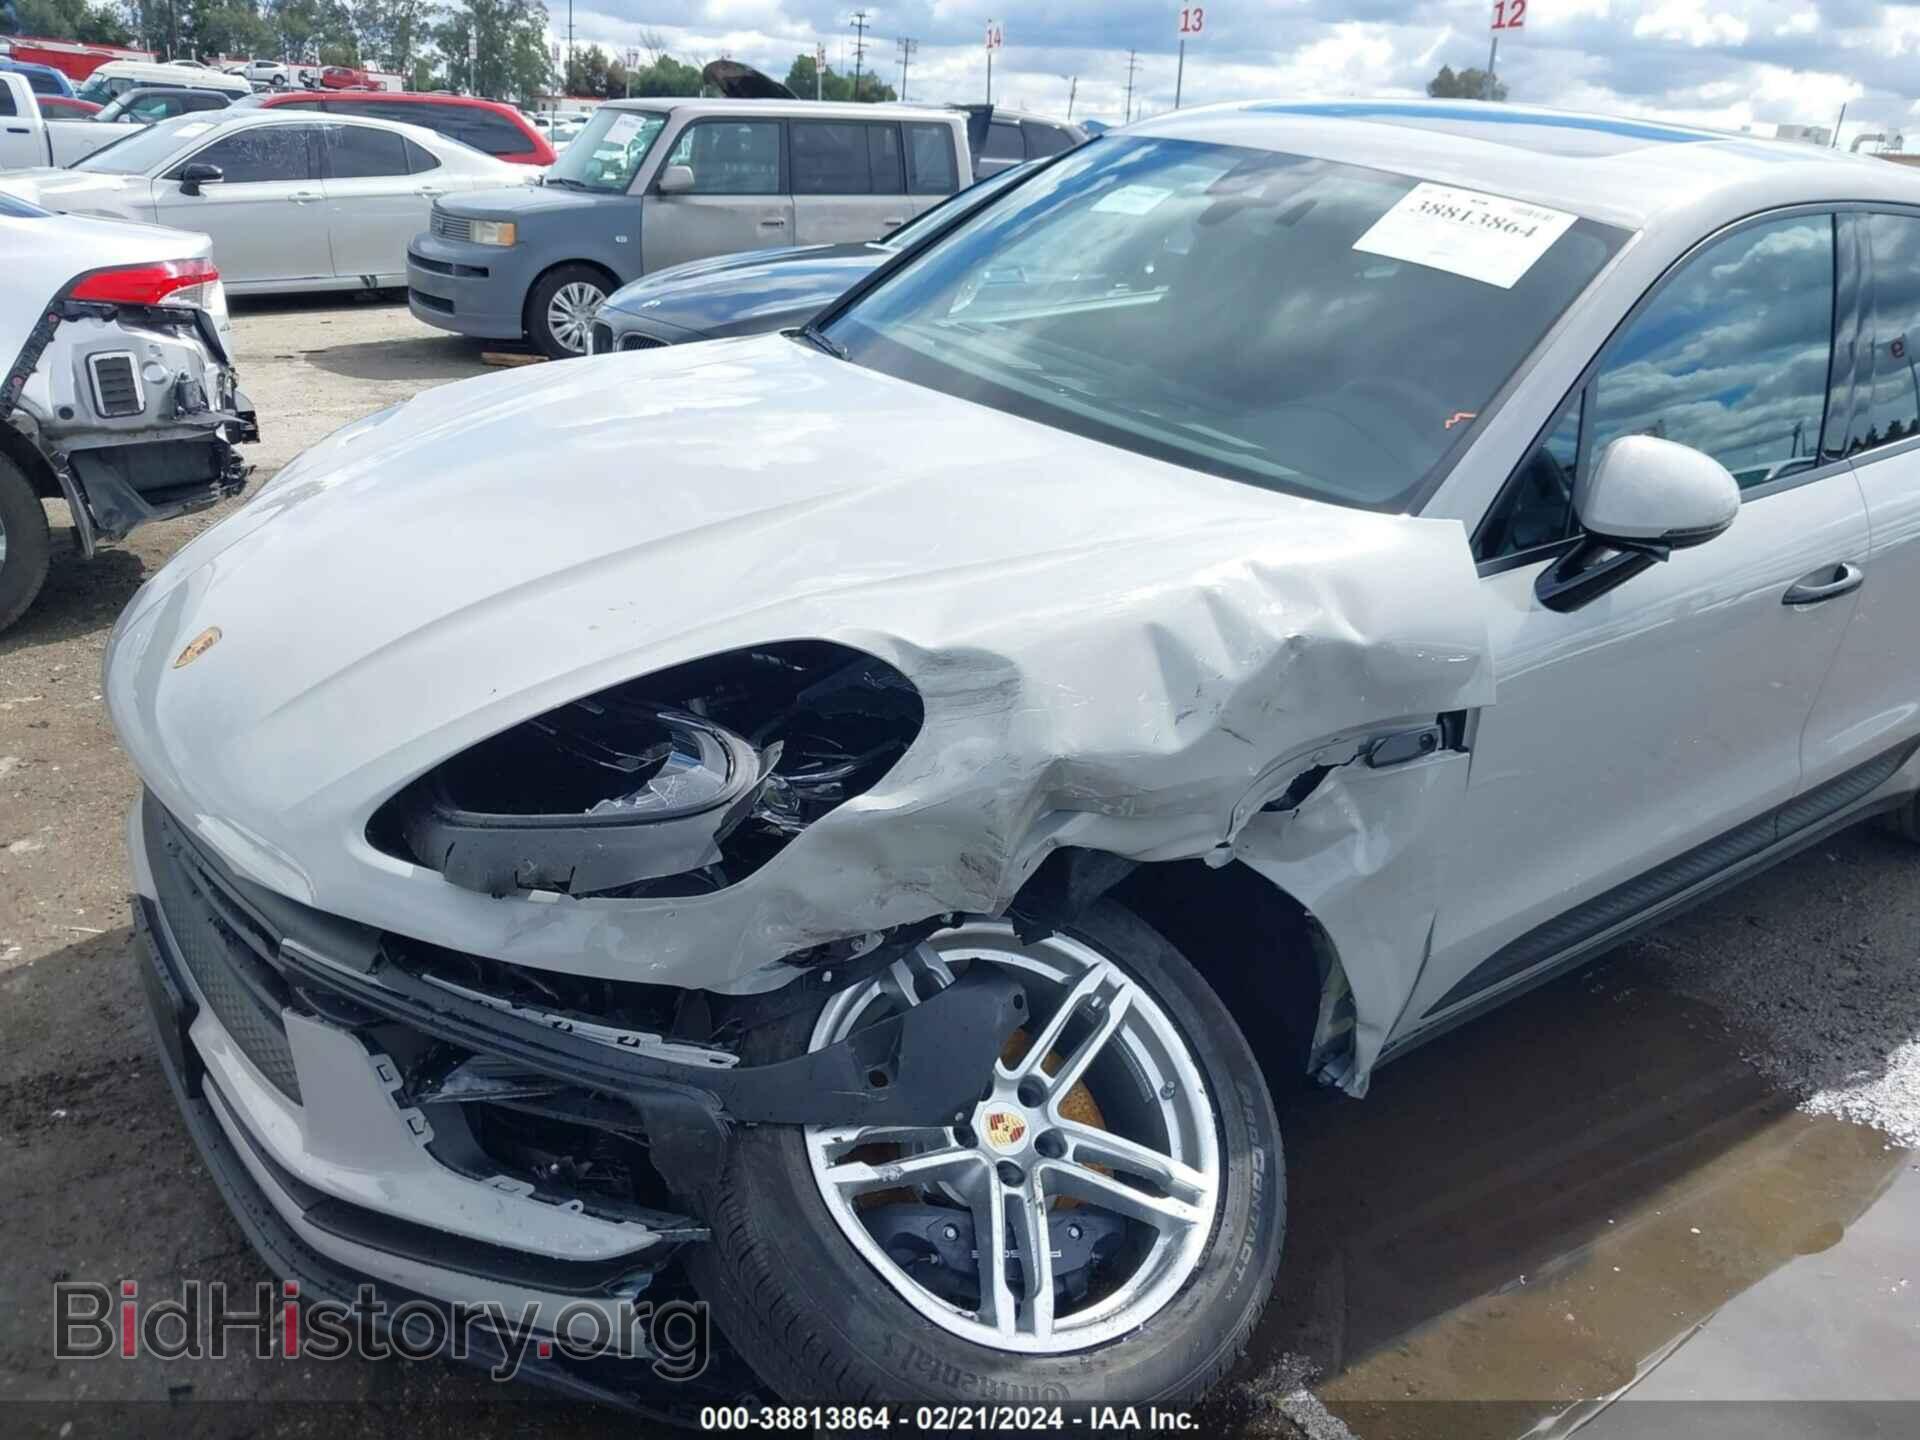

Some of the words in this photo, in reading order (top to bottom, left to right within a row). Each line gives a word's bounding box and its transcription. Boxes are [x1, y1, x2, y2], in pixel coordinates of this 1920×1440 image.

[1179, 8, 1204, 34] 13
[1491, 0, 1526, 30] 12
[985, 26, 1001, 49] 14
[1410, 198, 1538, 240] 38813864
